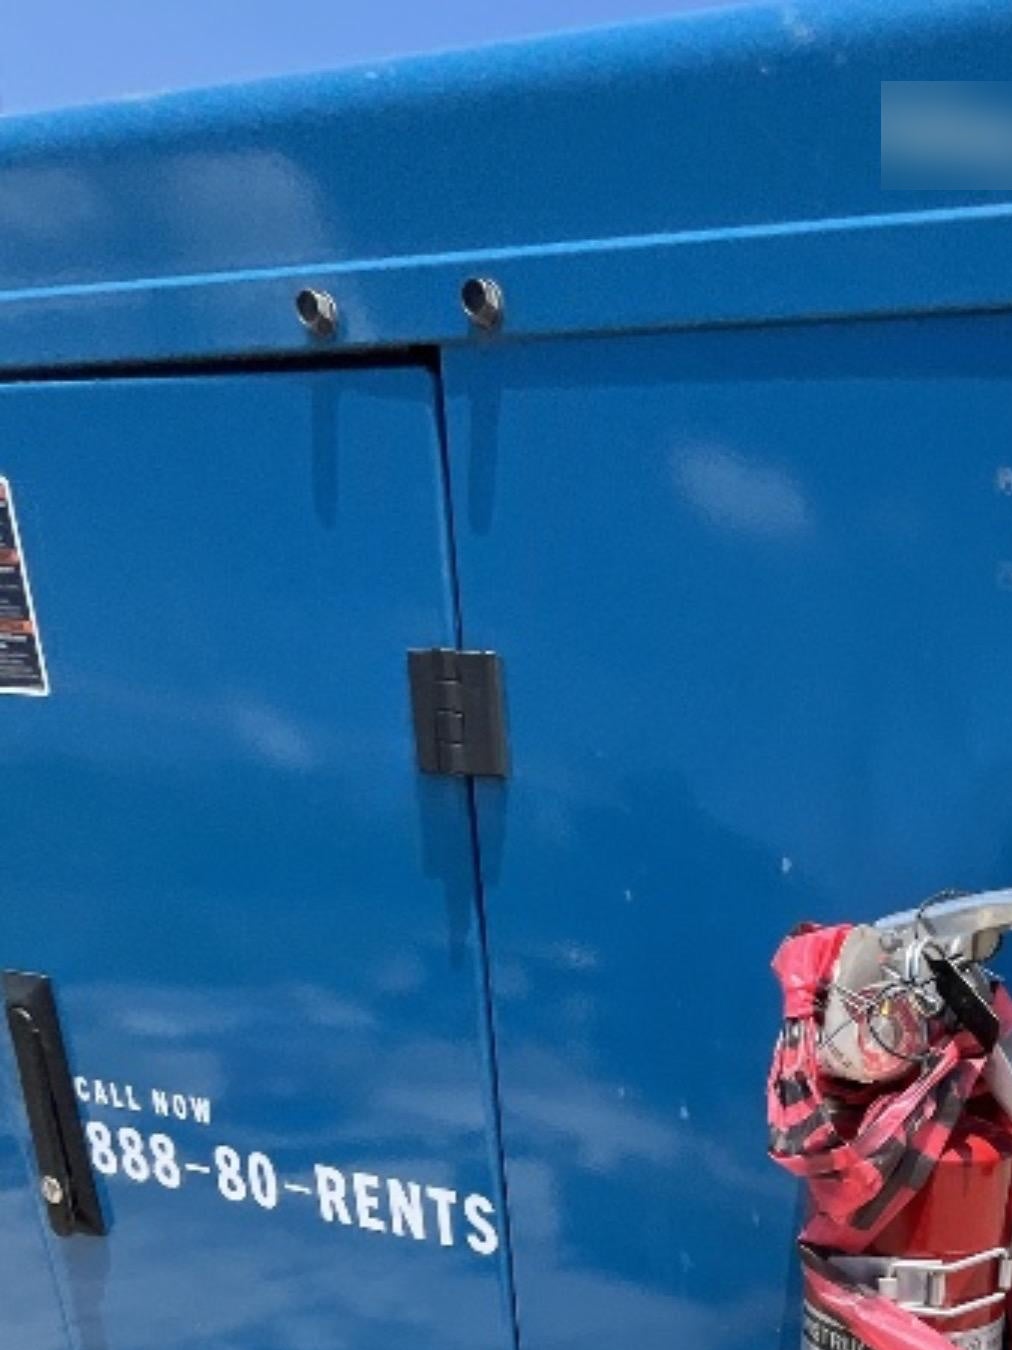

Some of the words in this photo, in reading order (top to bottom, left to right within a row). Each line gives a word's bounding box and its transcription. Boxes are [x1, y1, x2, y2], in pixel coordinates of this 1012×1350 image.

[74, 1076, 142, 1111] CALL
[151, 1088, 210, 1124] NOW
[85, 1120, 500, 1256] 888-80-RENTS
